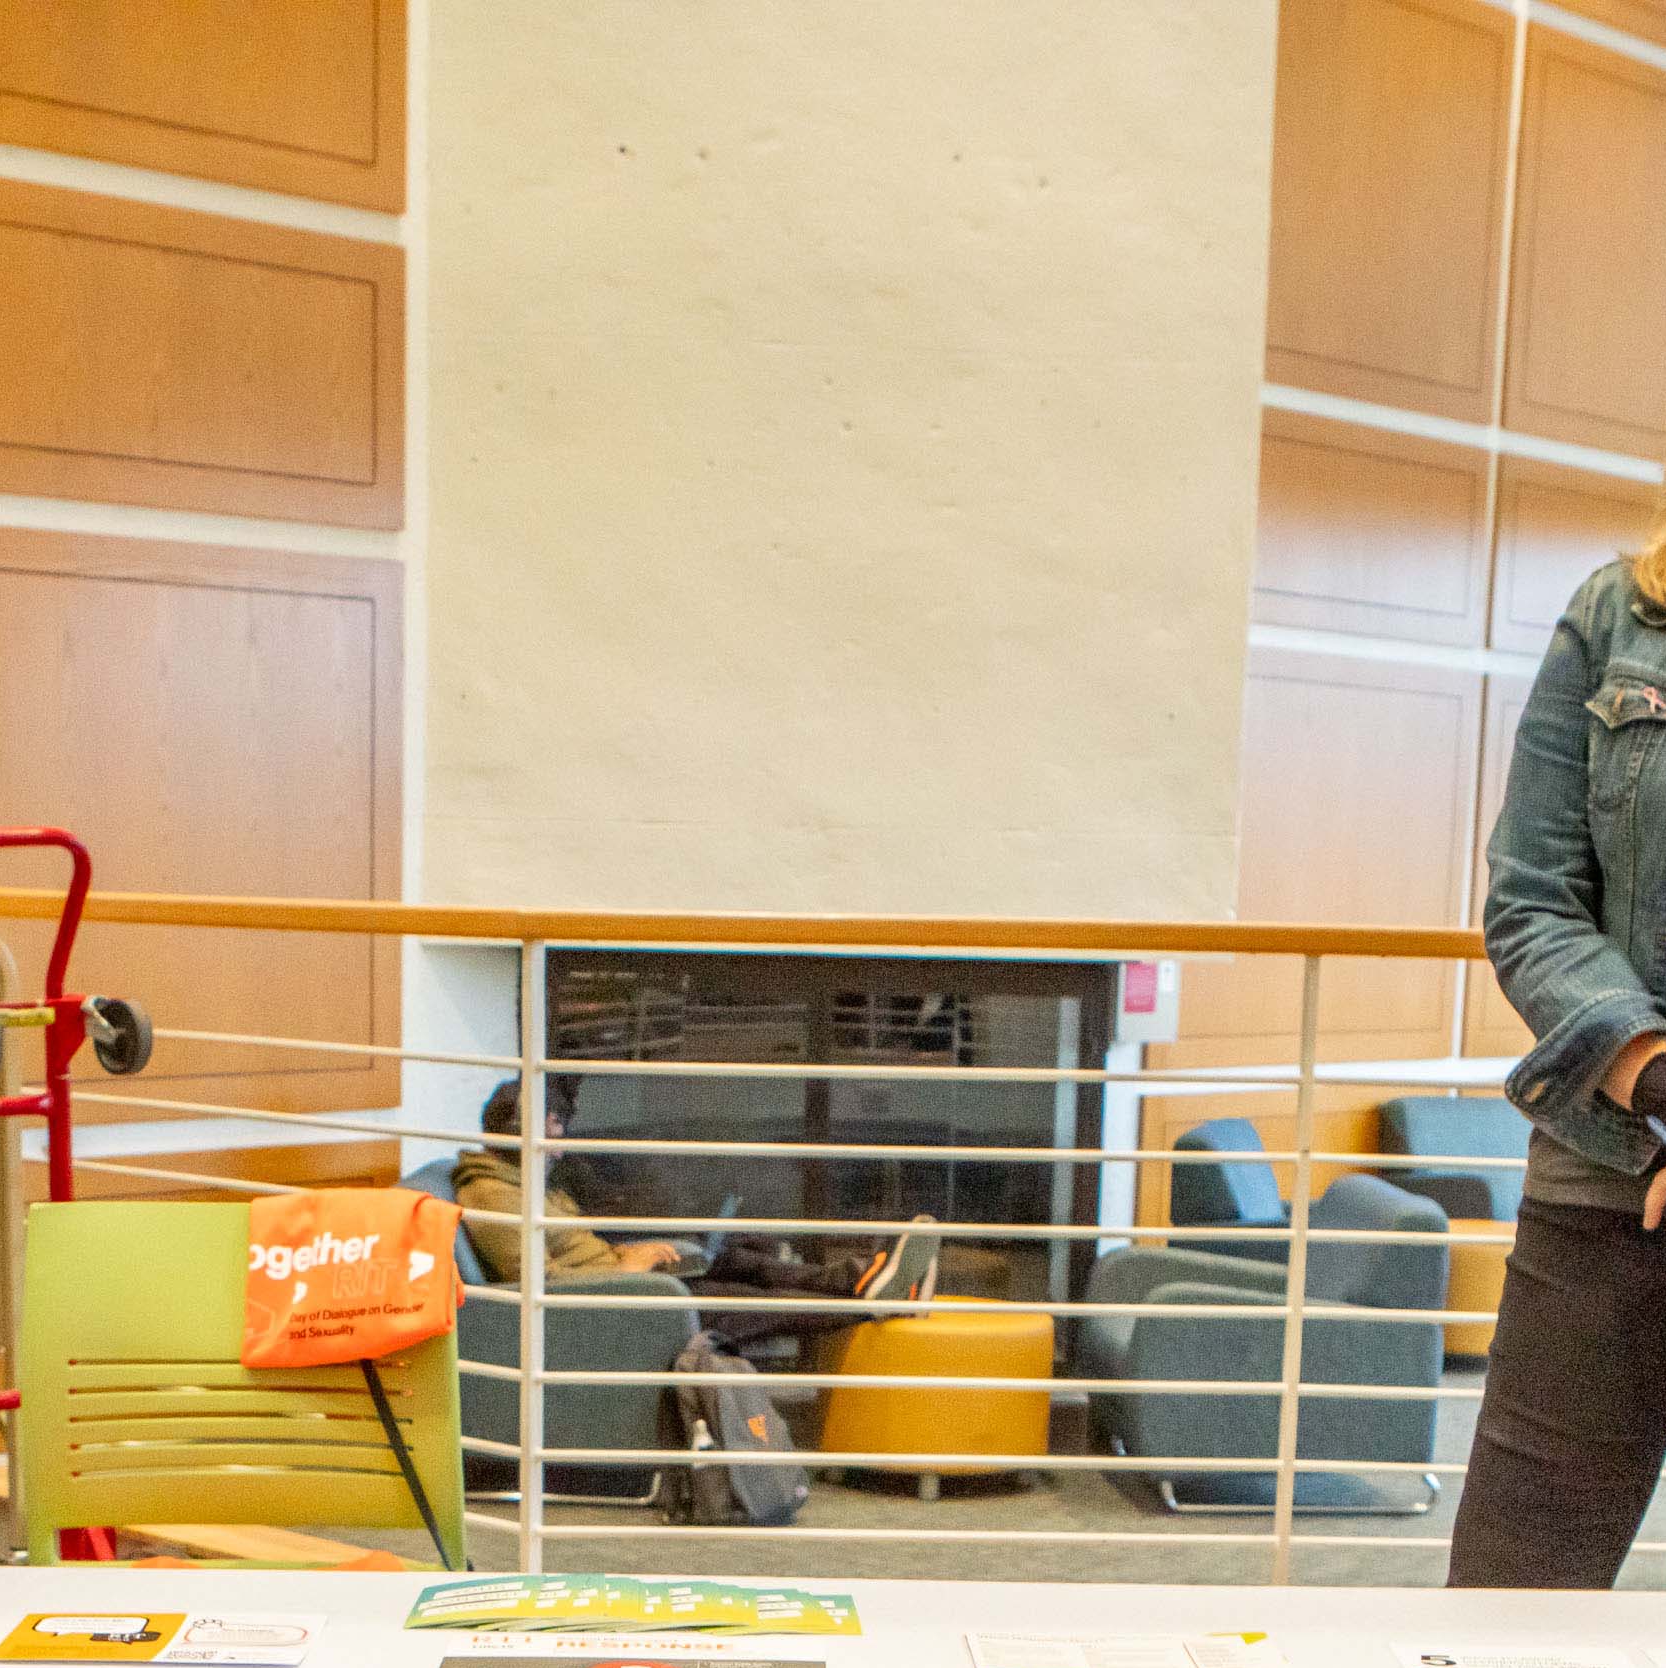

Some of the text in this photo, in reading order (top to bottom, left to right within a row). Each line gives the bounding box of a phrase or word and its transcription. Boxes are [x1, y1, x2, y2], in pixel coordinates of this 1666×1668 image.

[322, 1306, 366, 1320] Dialogue
[369, 1306, 381, 1315] on
[309, 1325, 355, 1339] Sexuality
